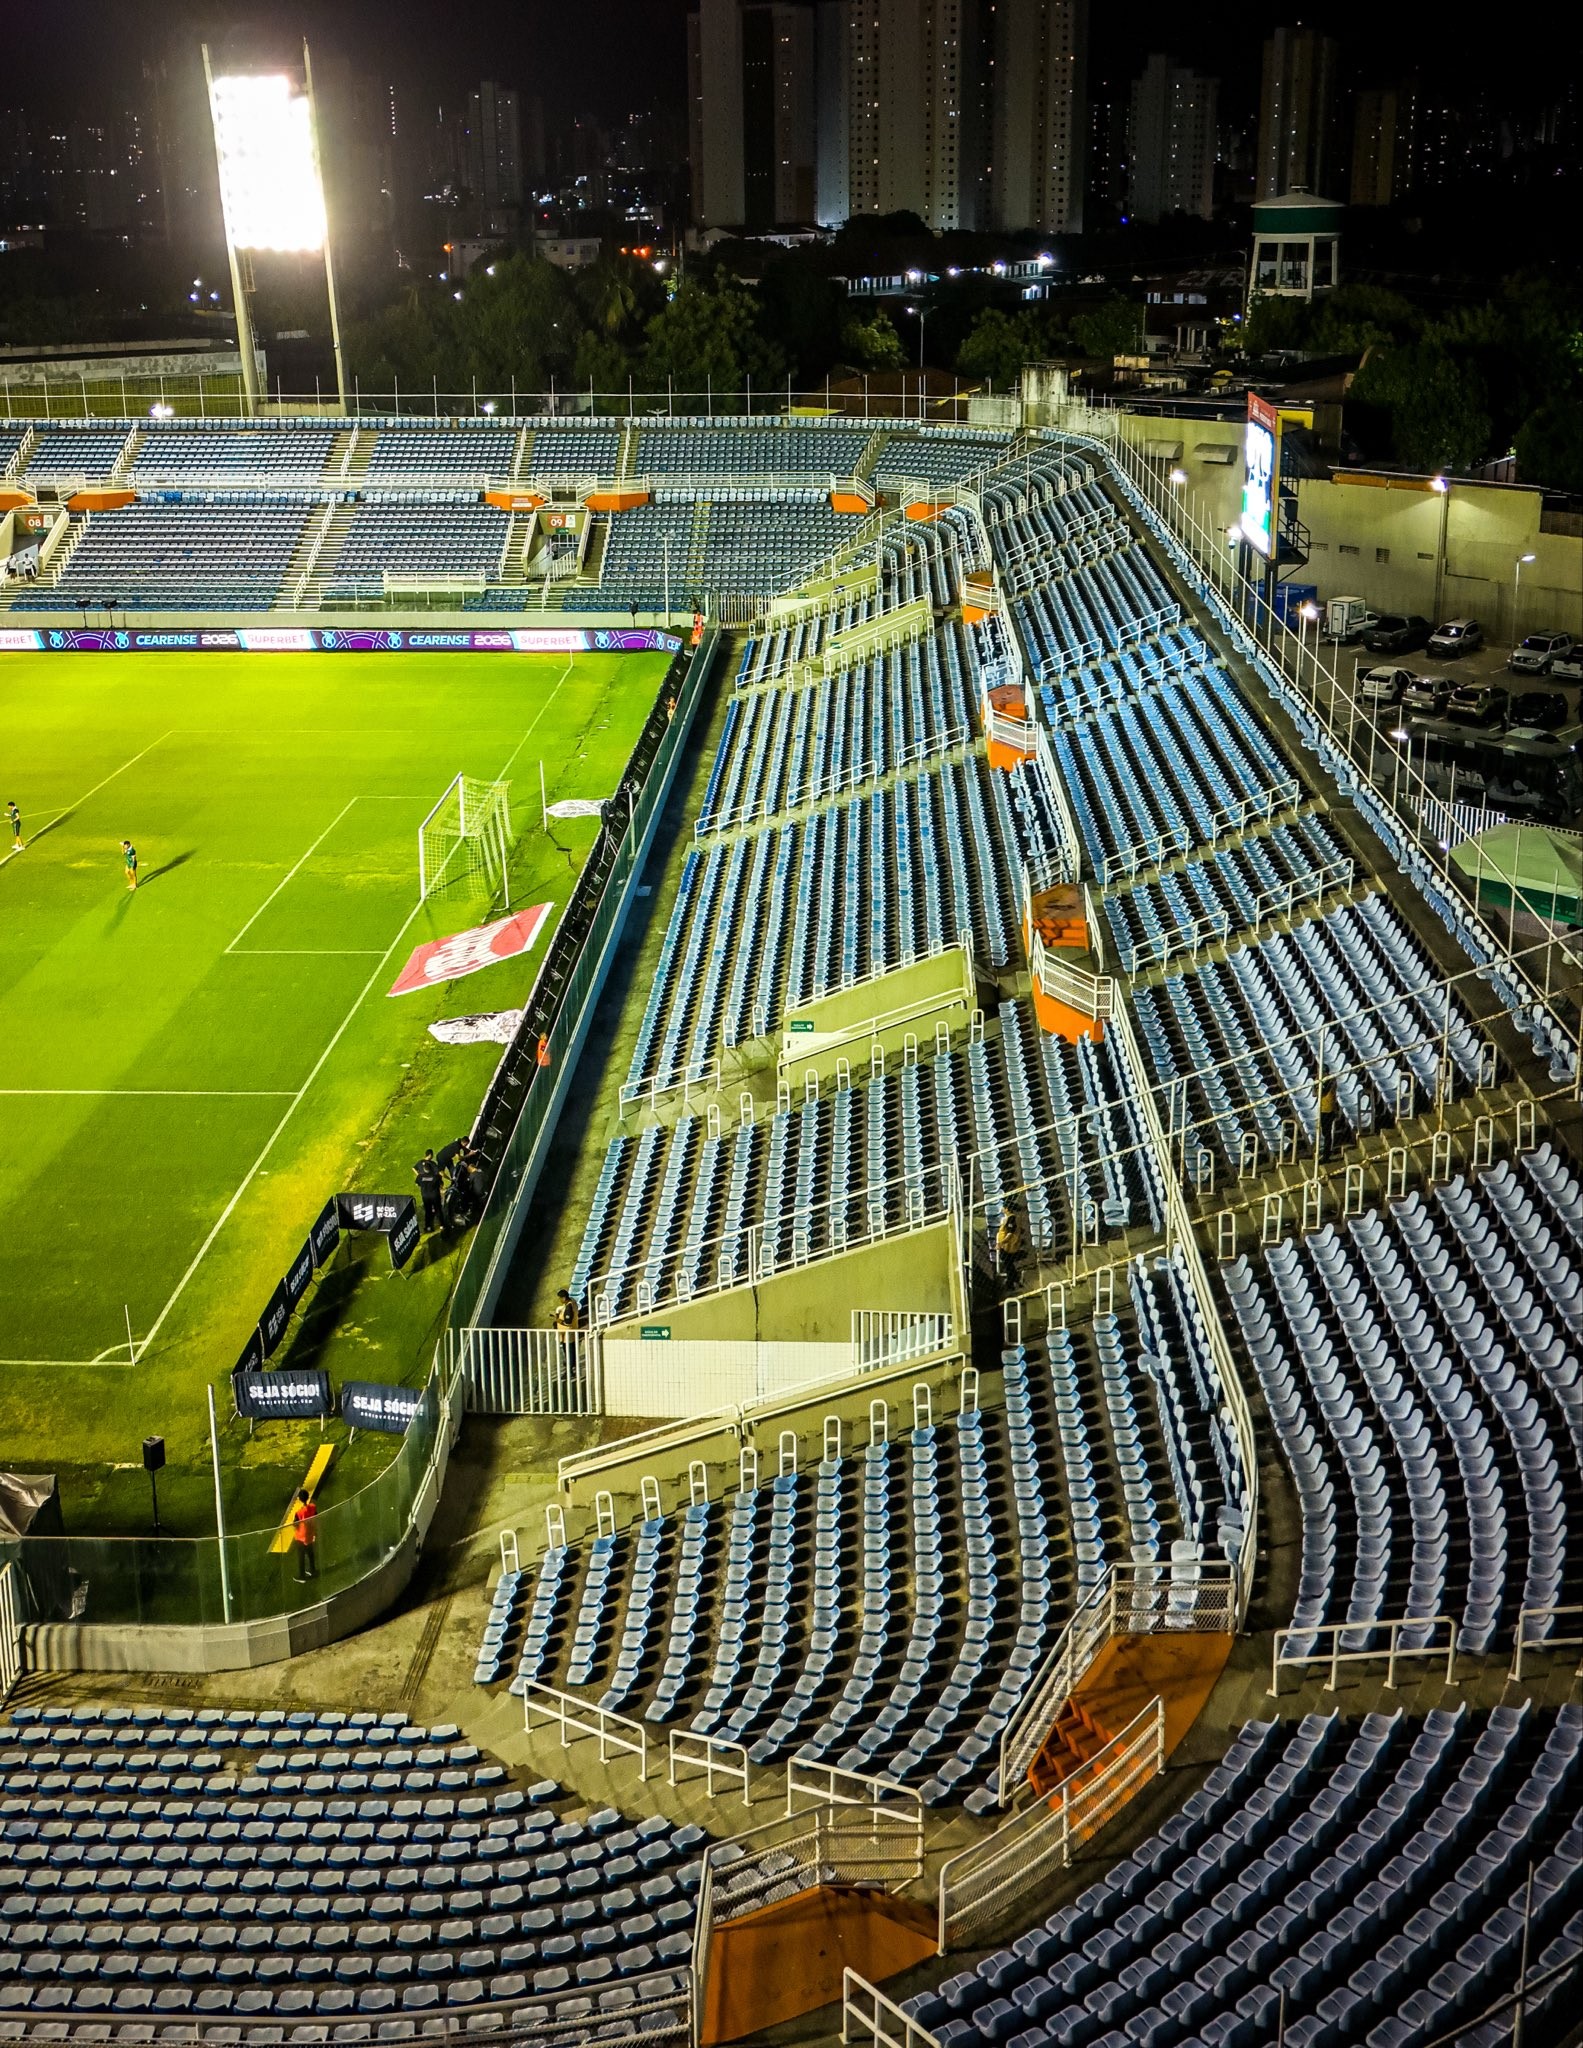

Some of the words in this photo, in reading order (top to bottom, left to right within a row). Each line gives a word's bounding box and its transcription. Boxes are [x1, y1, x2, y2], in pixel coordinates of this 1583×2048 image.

[28, 518, 41, 527] 08
[550, 518, 563, 527] 09
[136, 634, 197, 646] CEARENSE
[201, 634, 238, 645] 2026
[247, 634, 304, 645] SUPERBET
[409, 634, 470, 645] CEARENSE
[521, 635, 578, 646] SUPERBET
[249, 1385, 280, 1399] SEJA
[281, 1382, 320, 1399] SÓCIO!
[353, 1395, 382, 1412] SEJA
